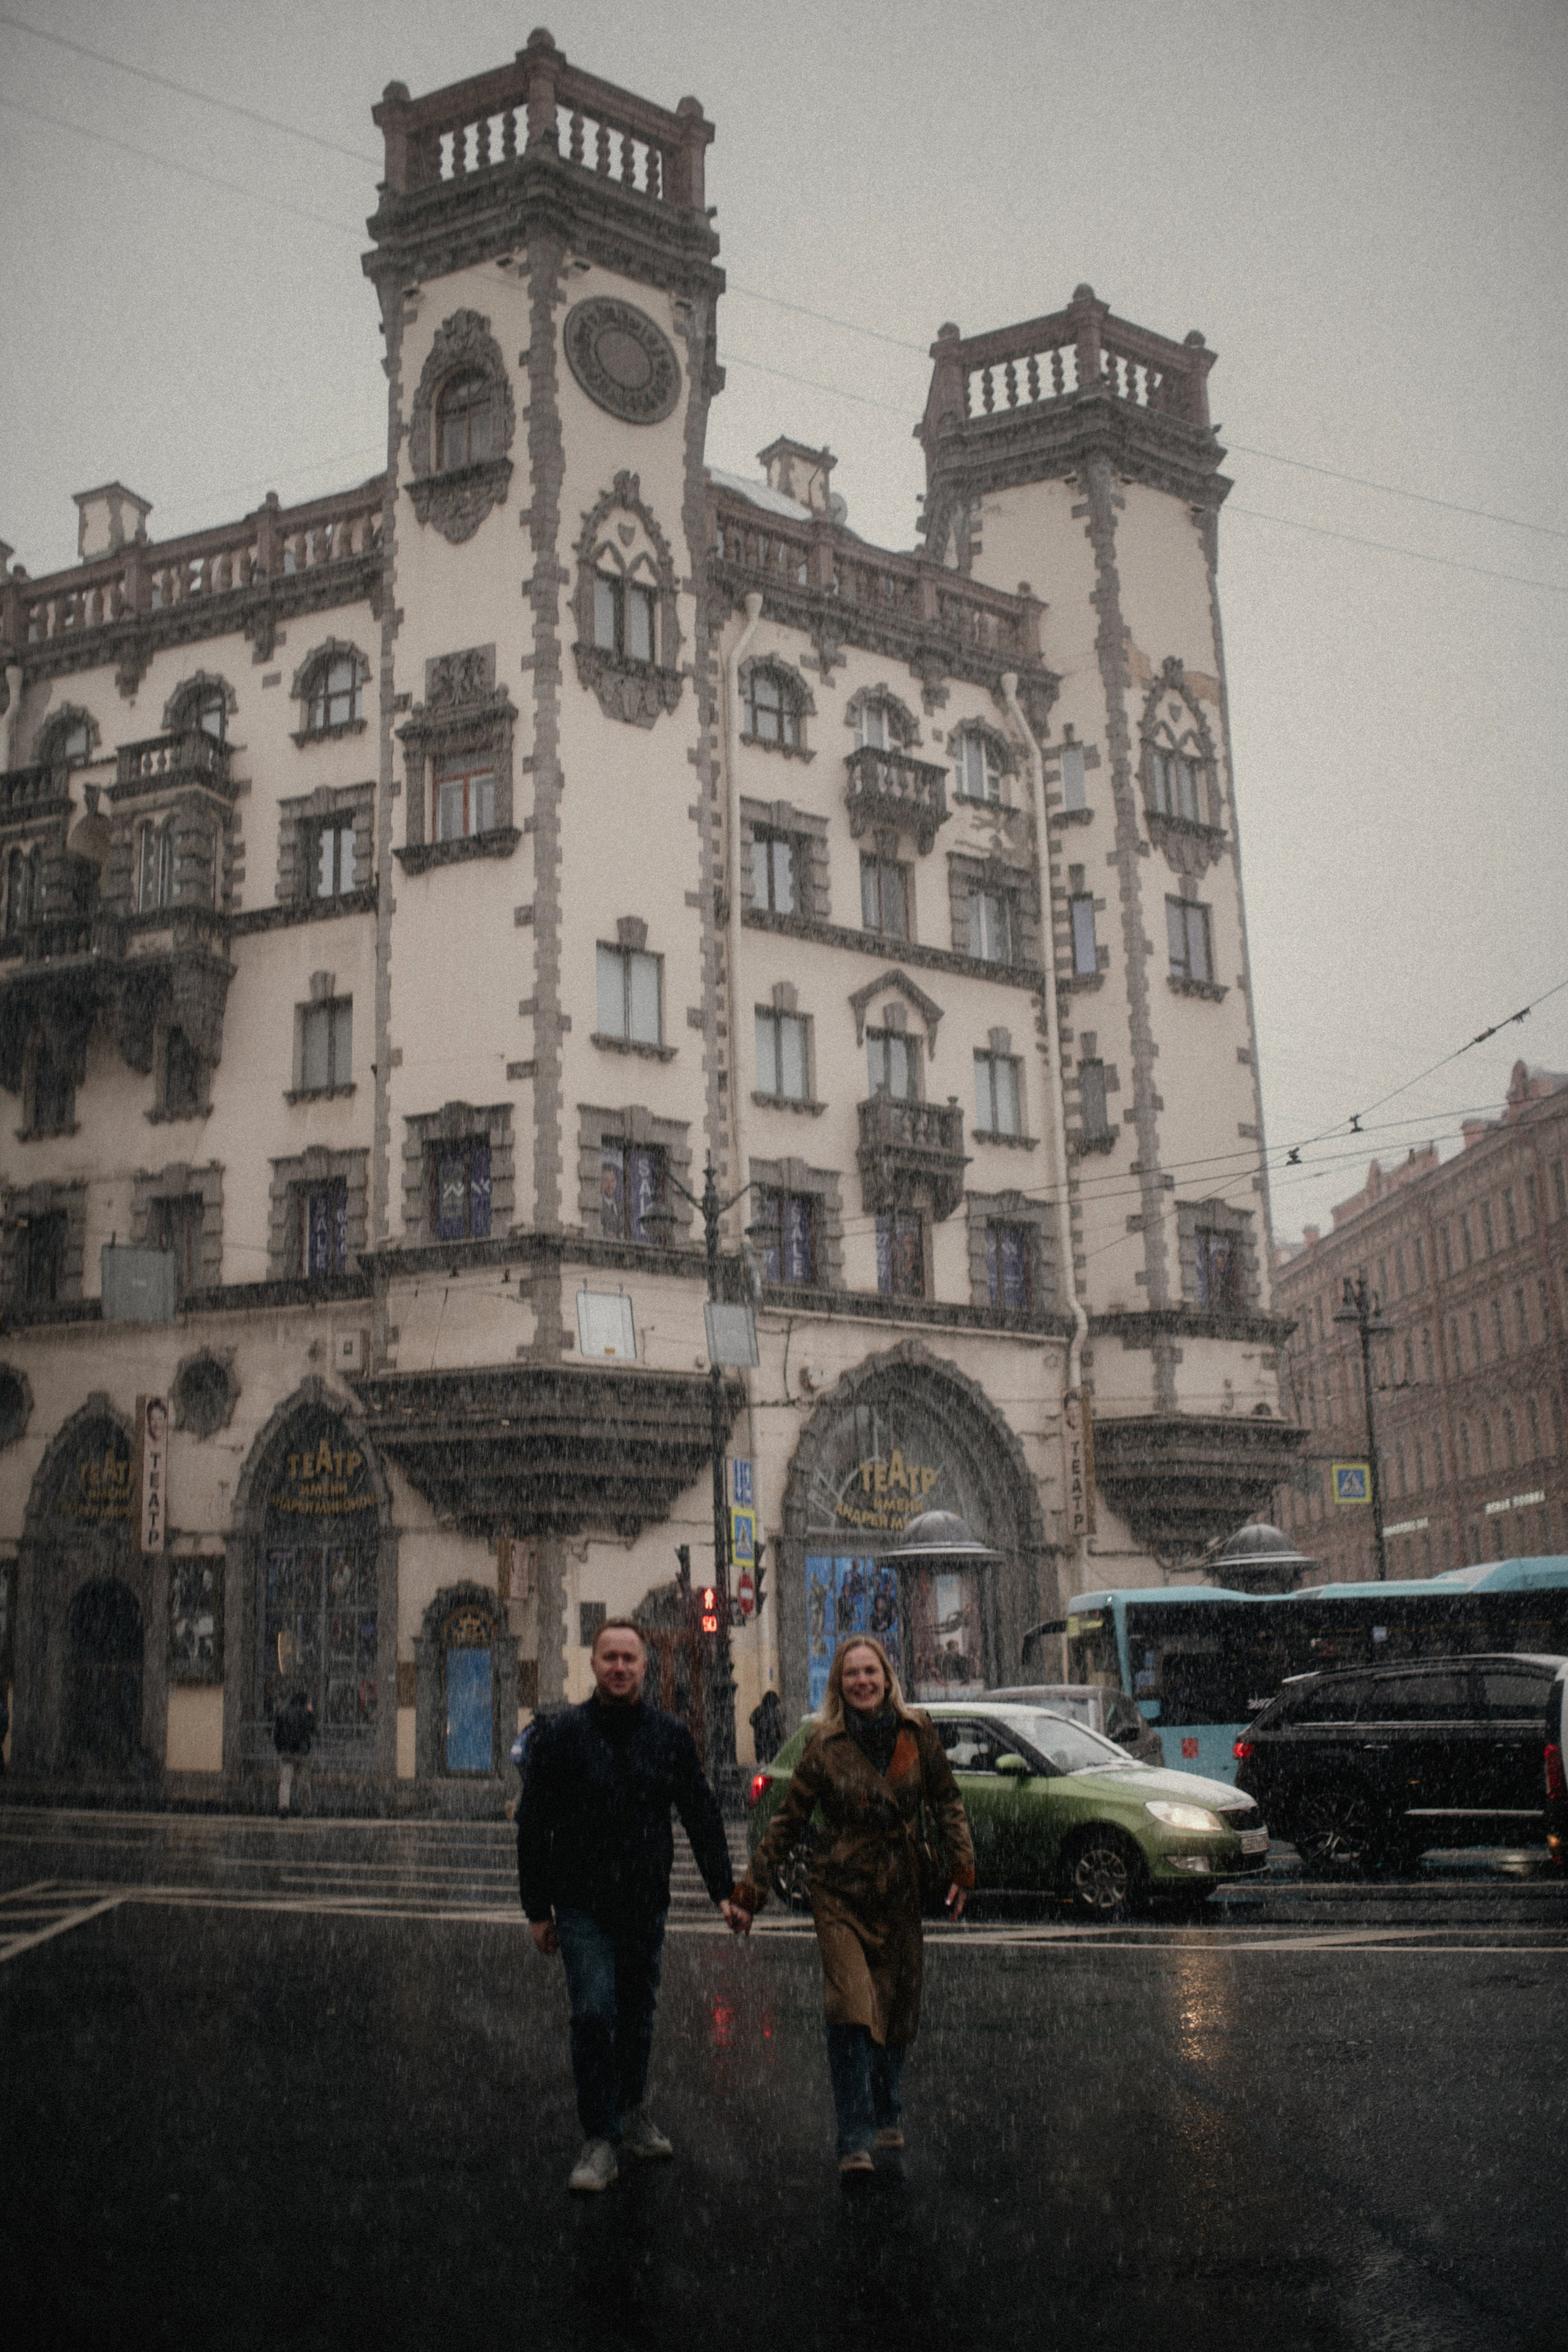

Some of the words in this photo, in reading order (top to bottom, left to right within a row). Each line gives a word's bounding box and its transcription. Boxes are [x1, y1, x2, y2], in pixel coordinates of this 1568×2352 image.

[791, 1205, 803, 1276] SALE
[287, 1438, 363, 1480] ТЕАТР
[859, 1449, 937, 1495] ТЕАТР
[1071, 1441, 1084, 1530] ТЕАТР
[148, 1453, 161, 1546] ТЕАТР
[873, 1497, 924, 1513] ИМЕНИ
